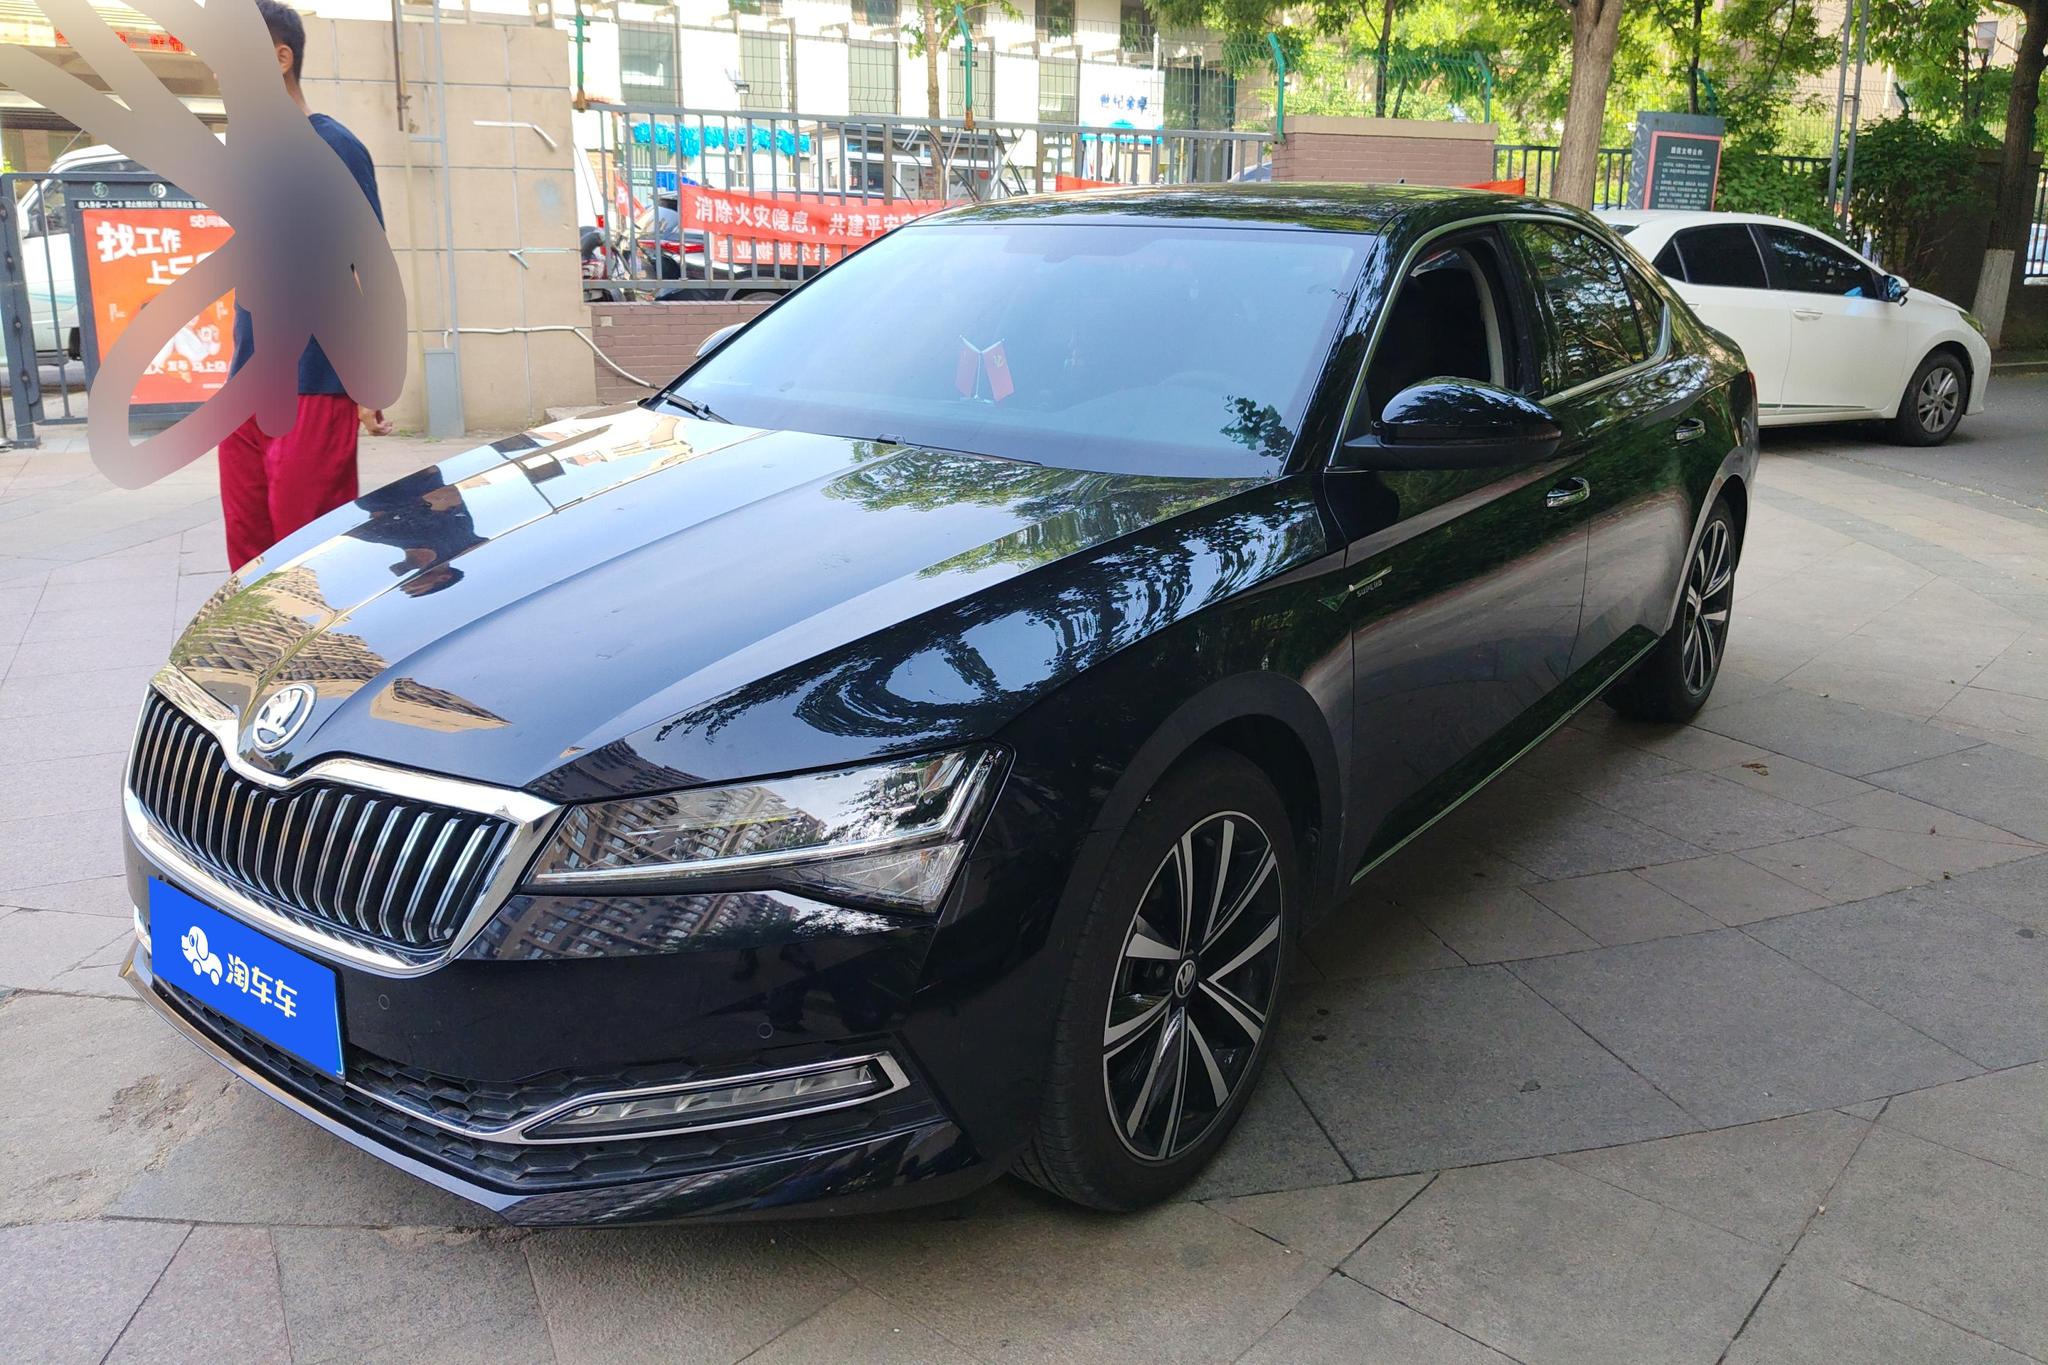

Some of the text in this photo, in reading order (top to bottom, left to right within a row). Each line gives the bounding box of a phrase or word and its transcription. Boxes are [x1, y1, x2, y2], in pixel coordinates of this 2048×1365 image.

[695, 196, 931, 239] 消除火灾隐患，共建平安
[96, 221, 182, 263] 找工作
